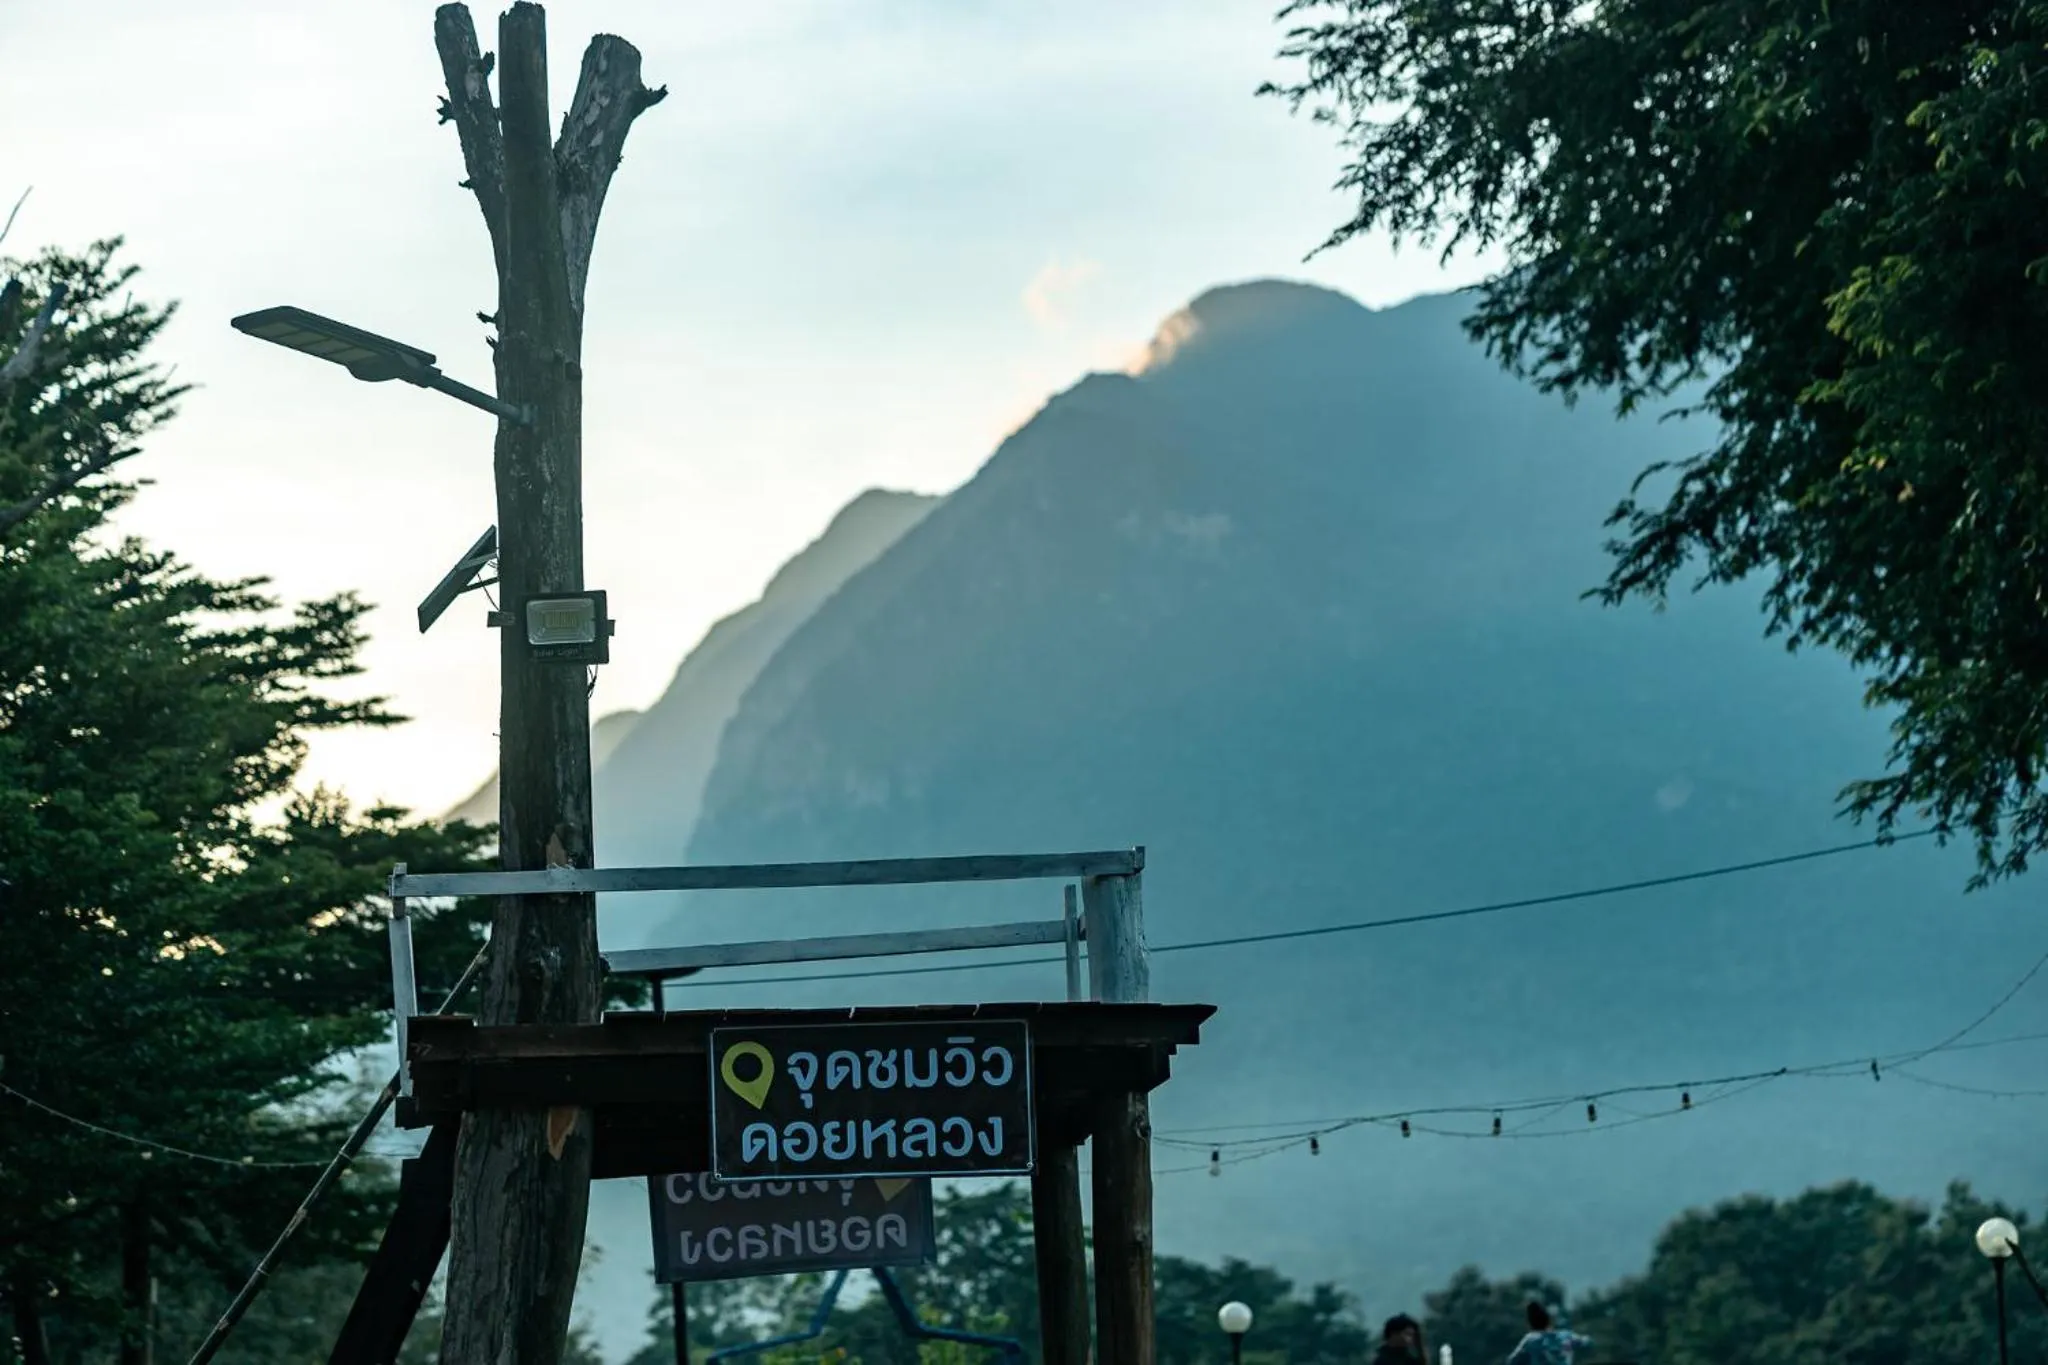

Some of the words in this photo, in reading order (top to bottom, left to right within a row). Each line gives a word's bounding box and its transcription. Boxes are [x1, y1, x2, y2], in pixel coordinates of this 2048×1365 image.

[787, 1036, 1013, 1109] จุดชมวิว
[741, 1116, 1003, 1163] ดอยหลวง
